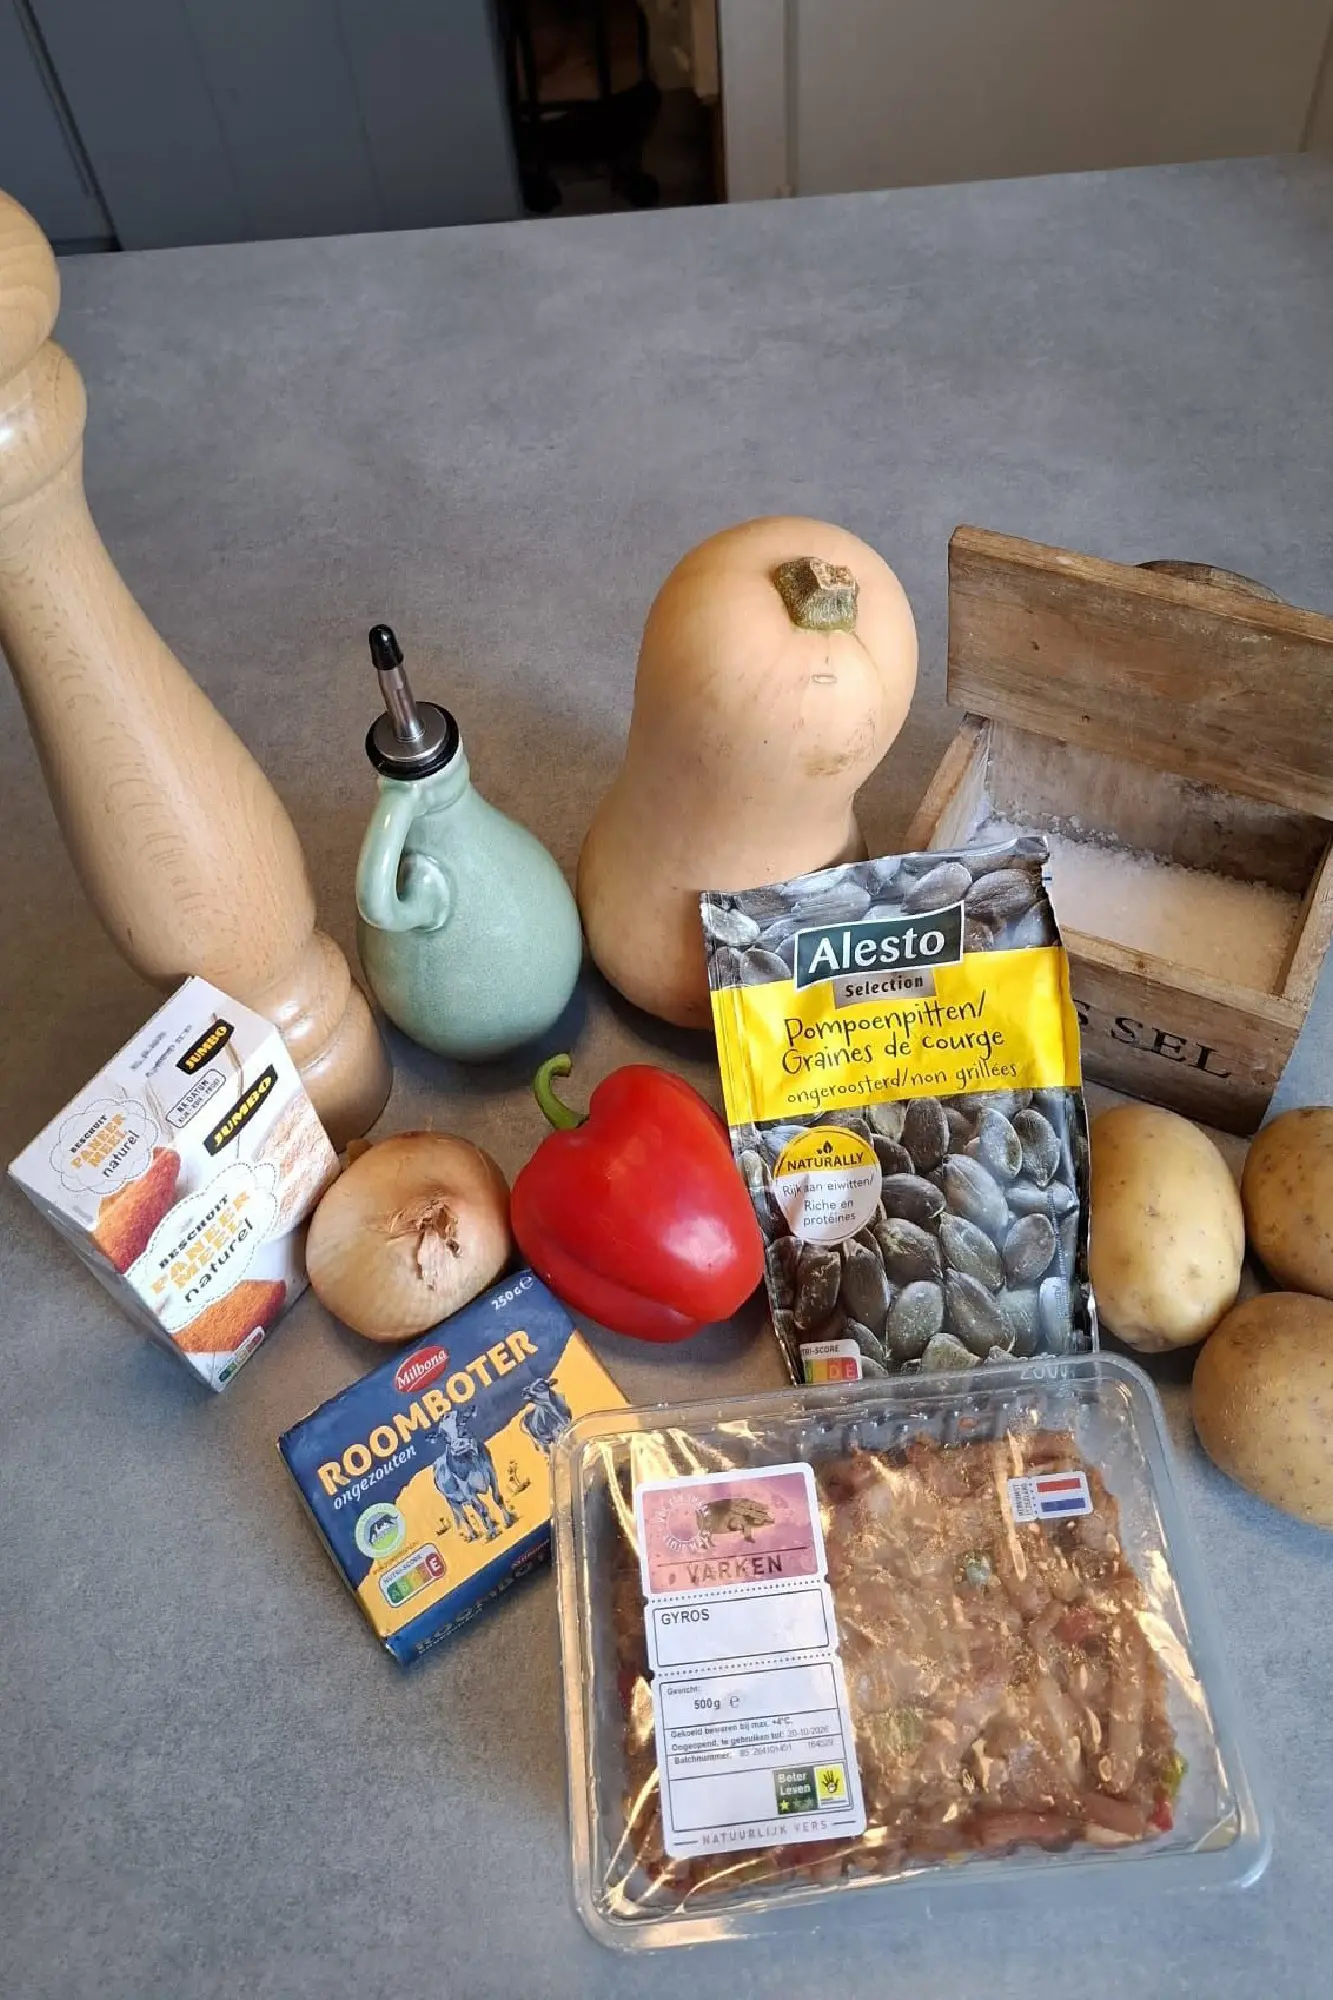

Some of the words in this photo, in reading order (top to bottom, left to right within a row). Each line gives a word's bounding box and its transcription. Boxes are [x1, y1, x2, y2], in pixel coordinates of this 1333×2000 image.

[808, 927, 945, 974] Alesto
[845, 975, 924, 998] Selection
[784, 989, 986, 1047] Pompoenpitten/
[185, 1026, 227, 1070] JUMBO
[782, 1043, 873, 1074] Graines
[884, 1032, 911, 1058] de
[922, 1029, 1005, 1060] courge
[1111, 1017, 1232, 1079] SEL
[955, 1060, 1017, 1090] grillées
[214, 1076, 272, 1147] JUMBO
[69, 1114, 107, 1154] BESCHUIT
[102, 1130, 140, 1178] naturel
[787, 1152, 864, 1172] NATURALLY
[804, 1199, 836, 1212] Riche
[841, 1200, 854, 1208] en
[152, 1191, 250, 1294] PANEER
[159, 1194, 228, 1269] BESCHUIT
[172, 1219, 243, 1290] MEEL
[185, 1217, 253, 1303] naturel
[397, 1350, 449, 1389] Milbona
[318, 1330, 539, 1496] ROOMBOTER
[334, 1444, 417, 1510] ongezouten
[429, 1556, 441, 1571] E
[686, 1554, 783, 1585] VARKEN
[661, 1608, 710, 1625] GYROS
[778, 1772, 807, 1783] Beter
[780, 1783, 811, 1796] Leven
[702, 1825, 788, 1846] NATUURLIJK
[794, 1820, 828, 1834] VERS
